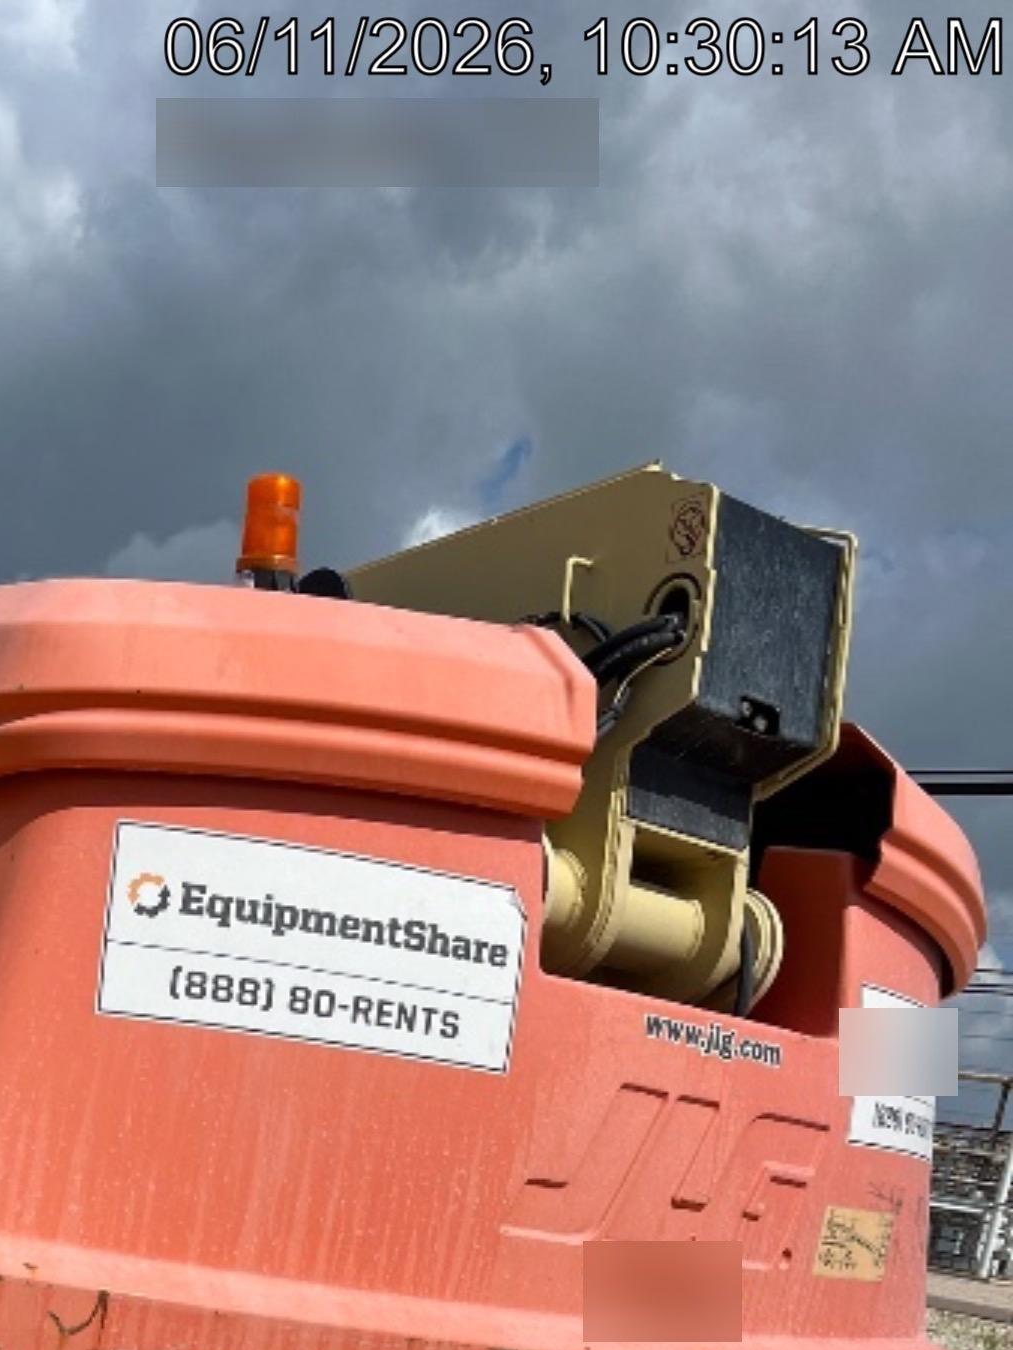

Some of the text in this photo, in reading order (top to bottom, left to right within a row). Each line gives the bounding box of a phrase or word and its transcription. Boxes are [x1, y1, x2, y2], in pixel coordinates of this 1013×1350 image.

[178, 880, 509, 969] EquipmentShare
[169, 964, 460, 1039] (888) 80-RENTS
[645, 1014, 781, 1065] www.jlg.com
